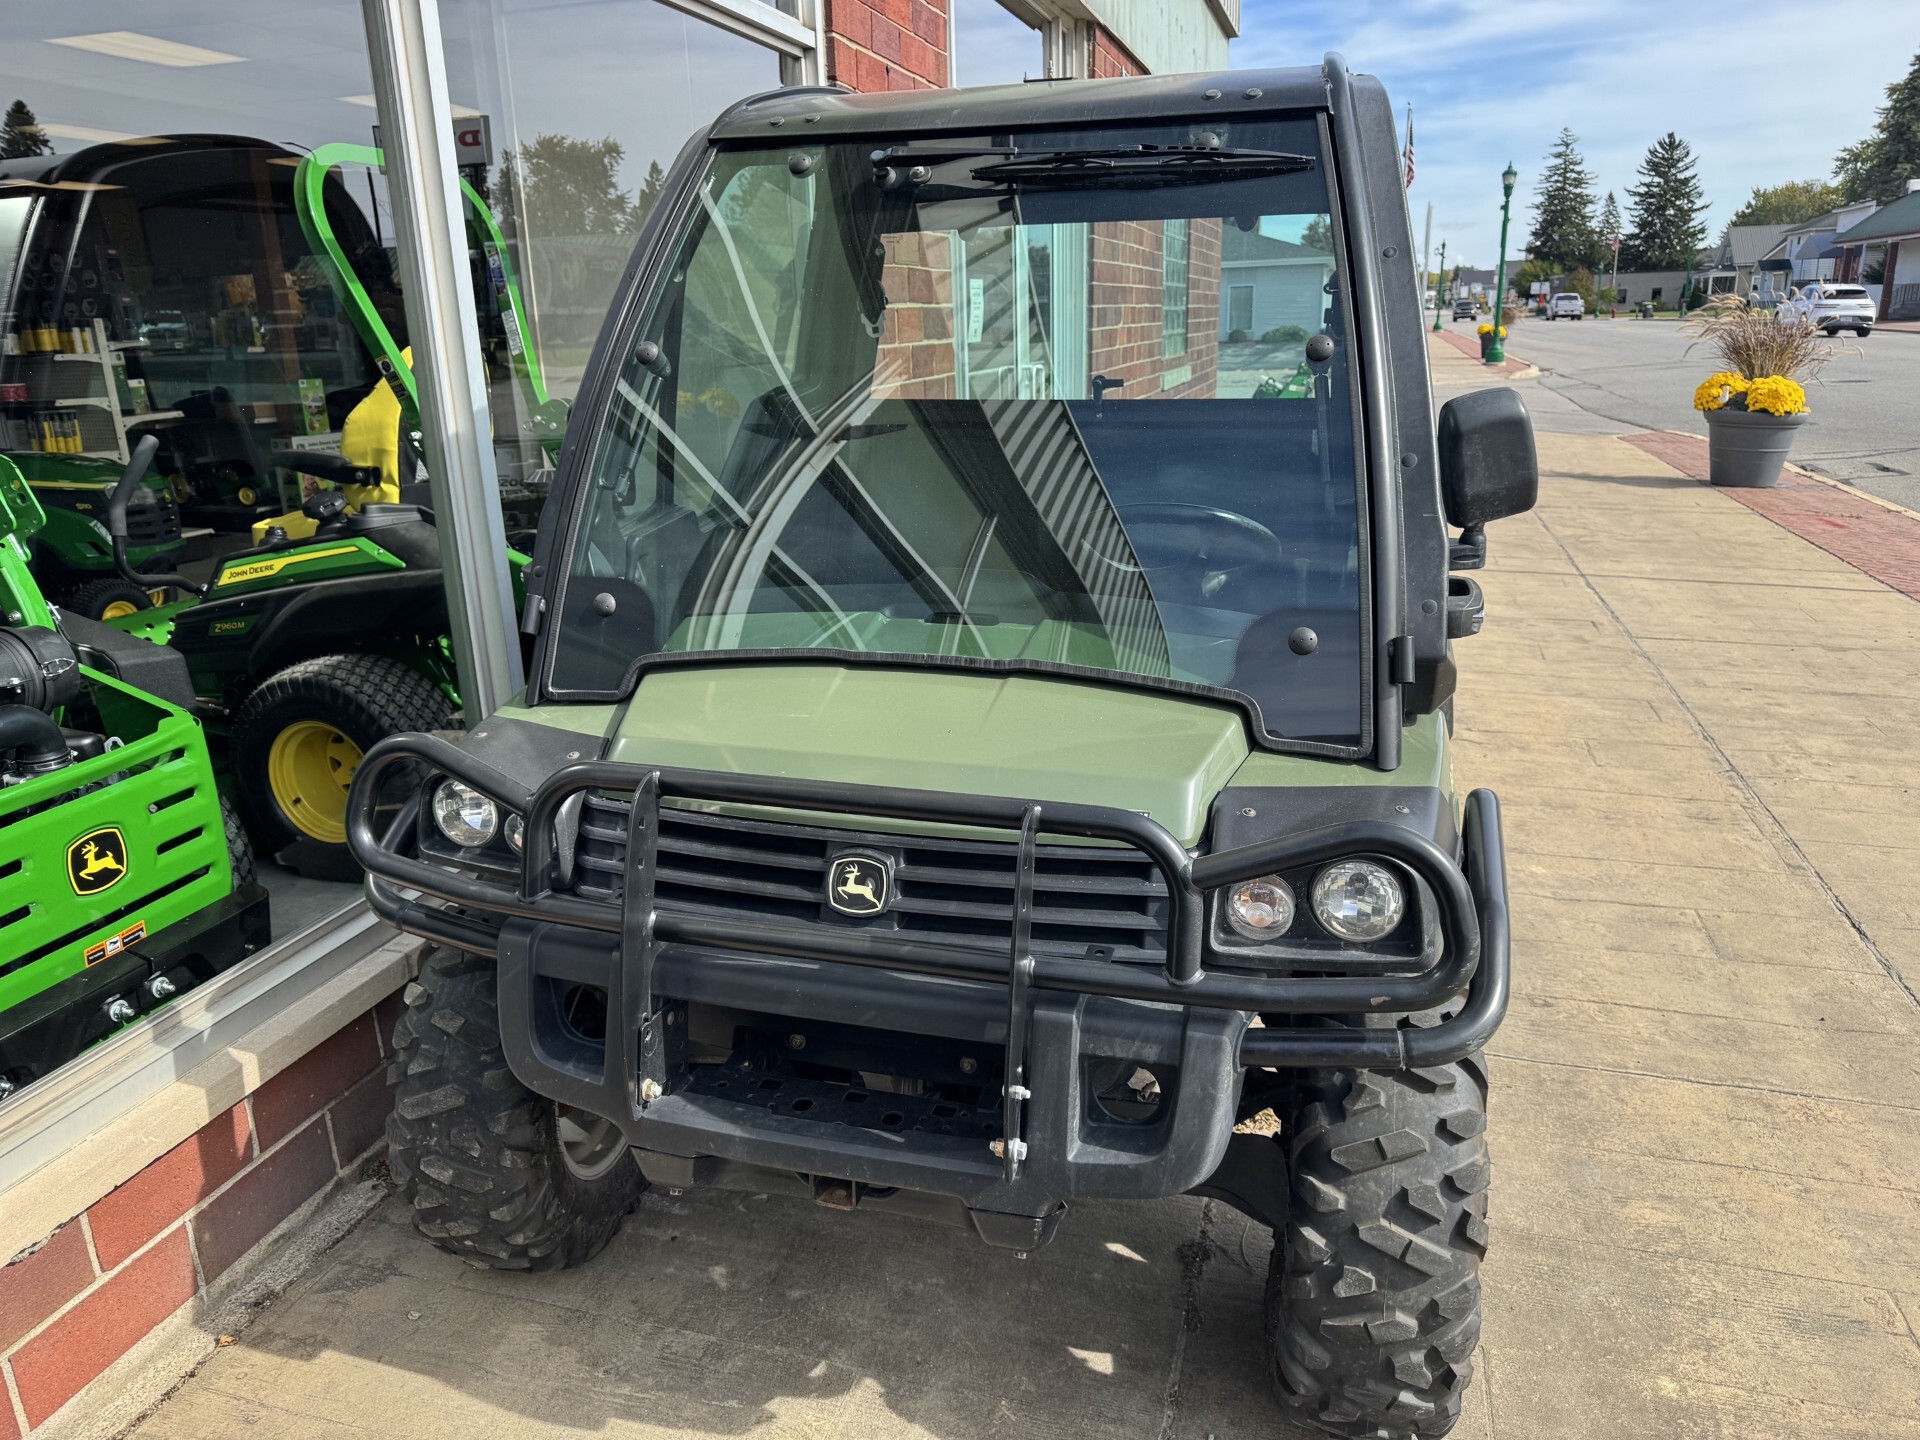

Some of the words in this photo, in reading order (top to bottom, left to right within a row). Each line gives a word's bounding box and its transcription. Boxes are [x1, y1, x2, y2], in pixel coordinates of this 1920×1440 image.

[228, 569, 248, 579] JOHN
[249, 564, 275, 575] DEERE
[214, 621, 245, 632] Z960M
